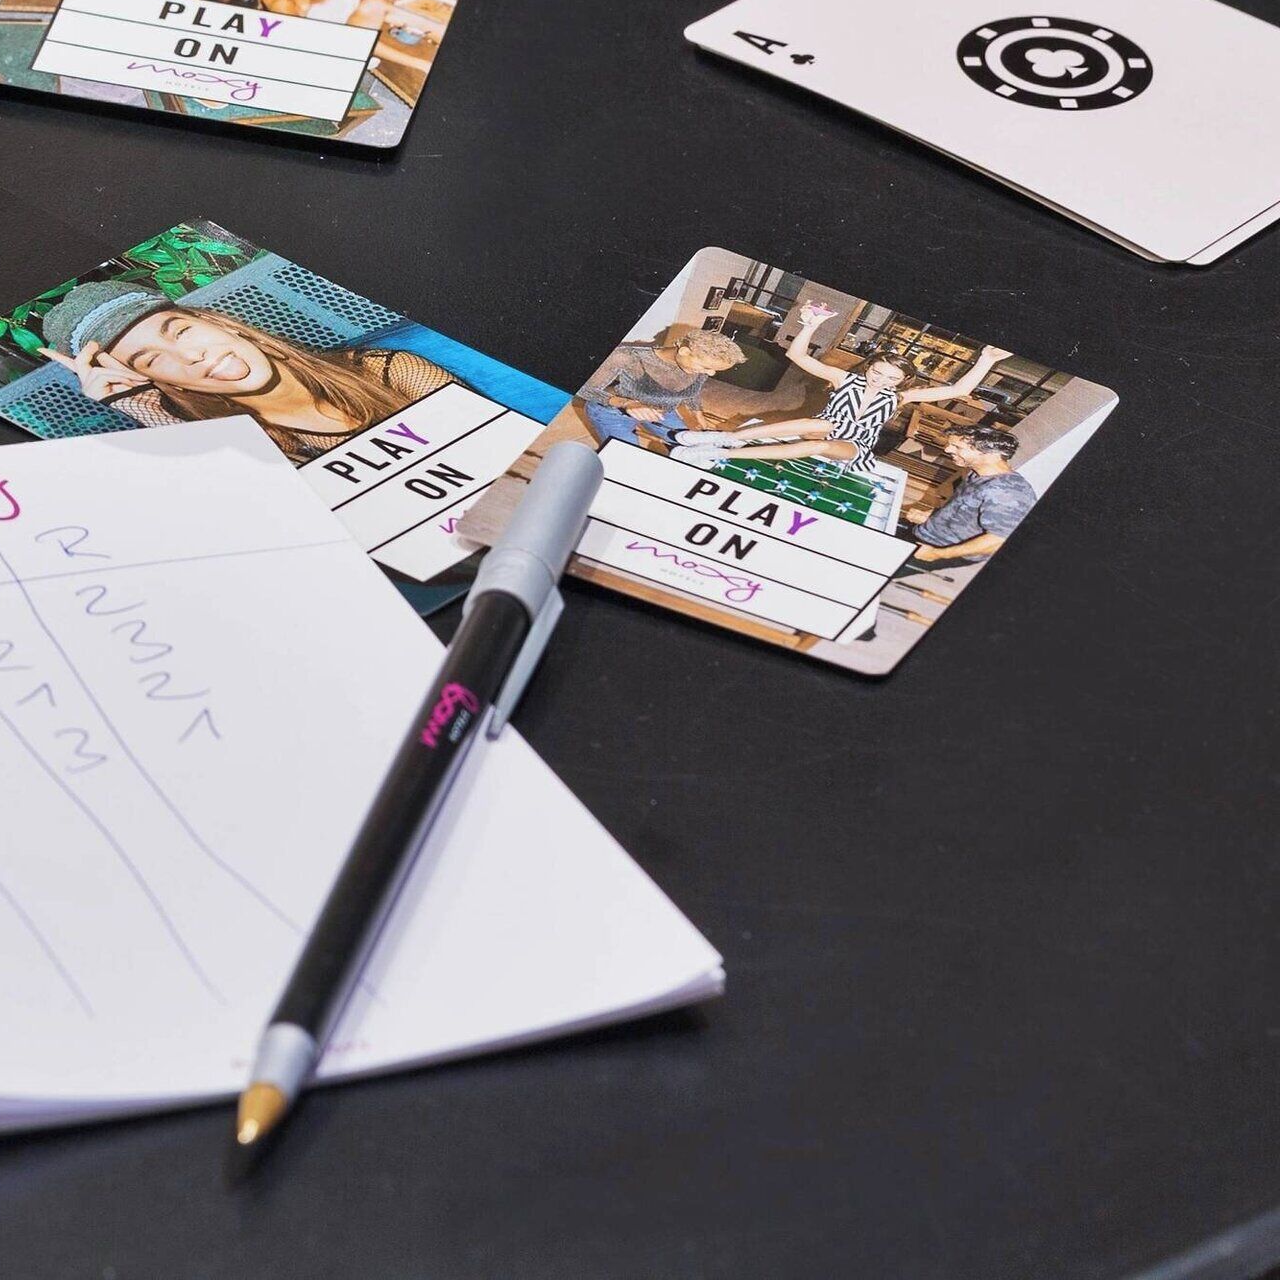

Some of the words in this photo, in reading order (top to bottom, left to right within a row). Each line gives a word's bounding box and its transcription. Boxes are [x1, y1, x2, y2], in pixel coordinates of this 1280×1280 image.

[158, 0, 284, 39] PLAY
[173, 37, 239, 66] ON
[732, 29, 788, 56] A
[322, 422, 430, 484] PLAY
[404, 463, 476, 500] ON
[685, 477, 820, 537] PLAY
[684, 522, 759, 561] ON
